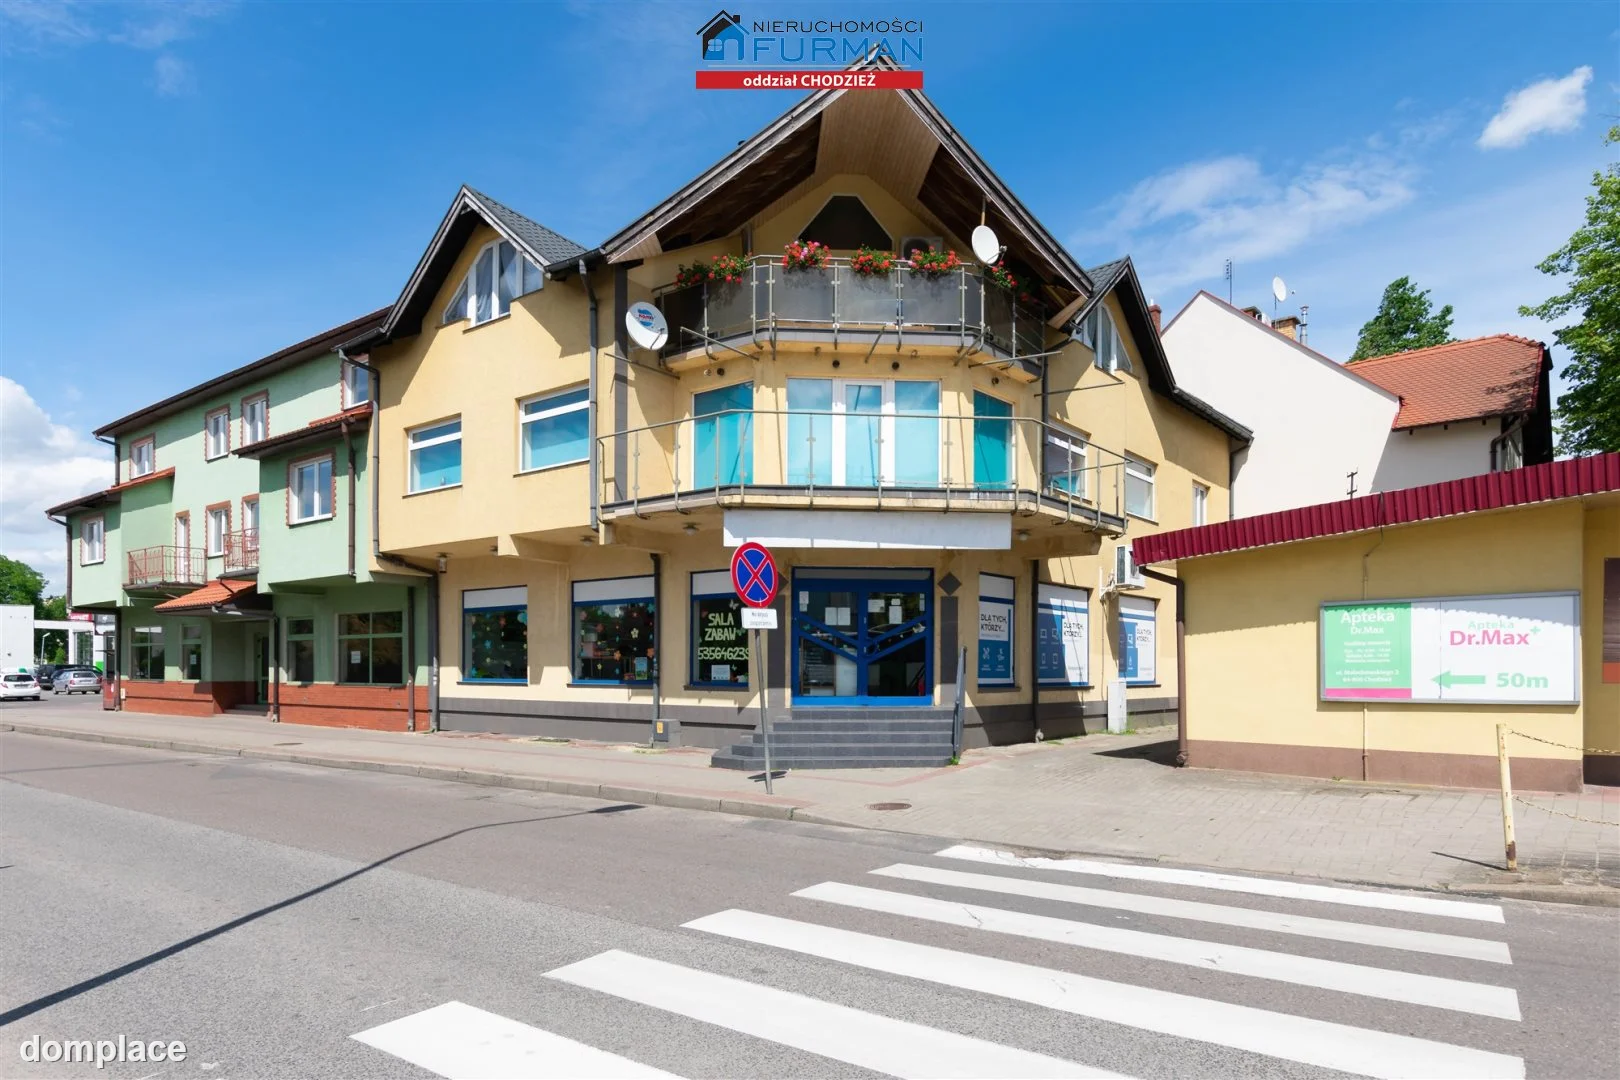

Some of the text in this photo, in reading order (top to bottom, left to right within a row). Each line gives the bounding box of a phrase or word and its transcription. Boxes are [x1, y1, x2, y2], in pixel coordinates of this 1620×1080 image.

[708, 612, 734, 626] SALA
[1340, 610, 1395, 626] Apteka
[1467, 620, 1515, 631] Apteka
[704, 627, 736, 641] ZABAW
[1449, 629, 1530, 646] Dr.Max
[1496, 672, 1549, 688] 50m
